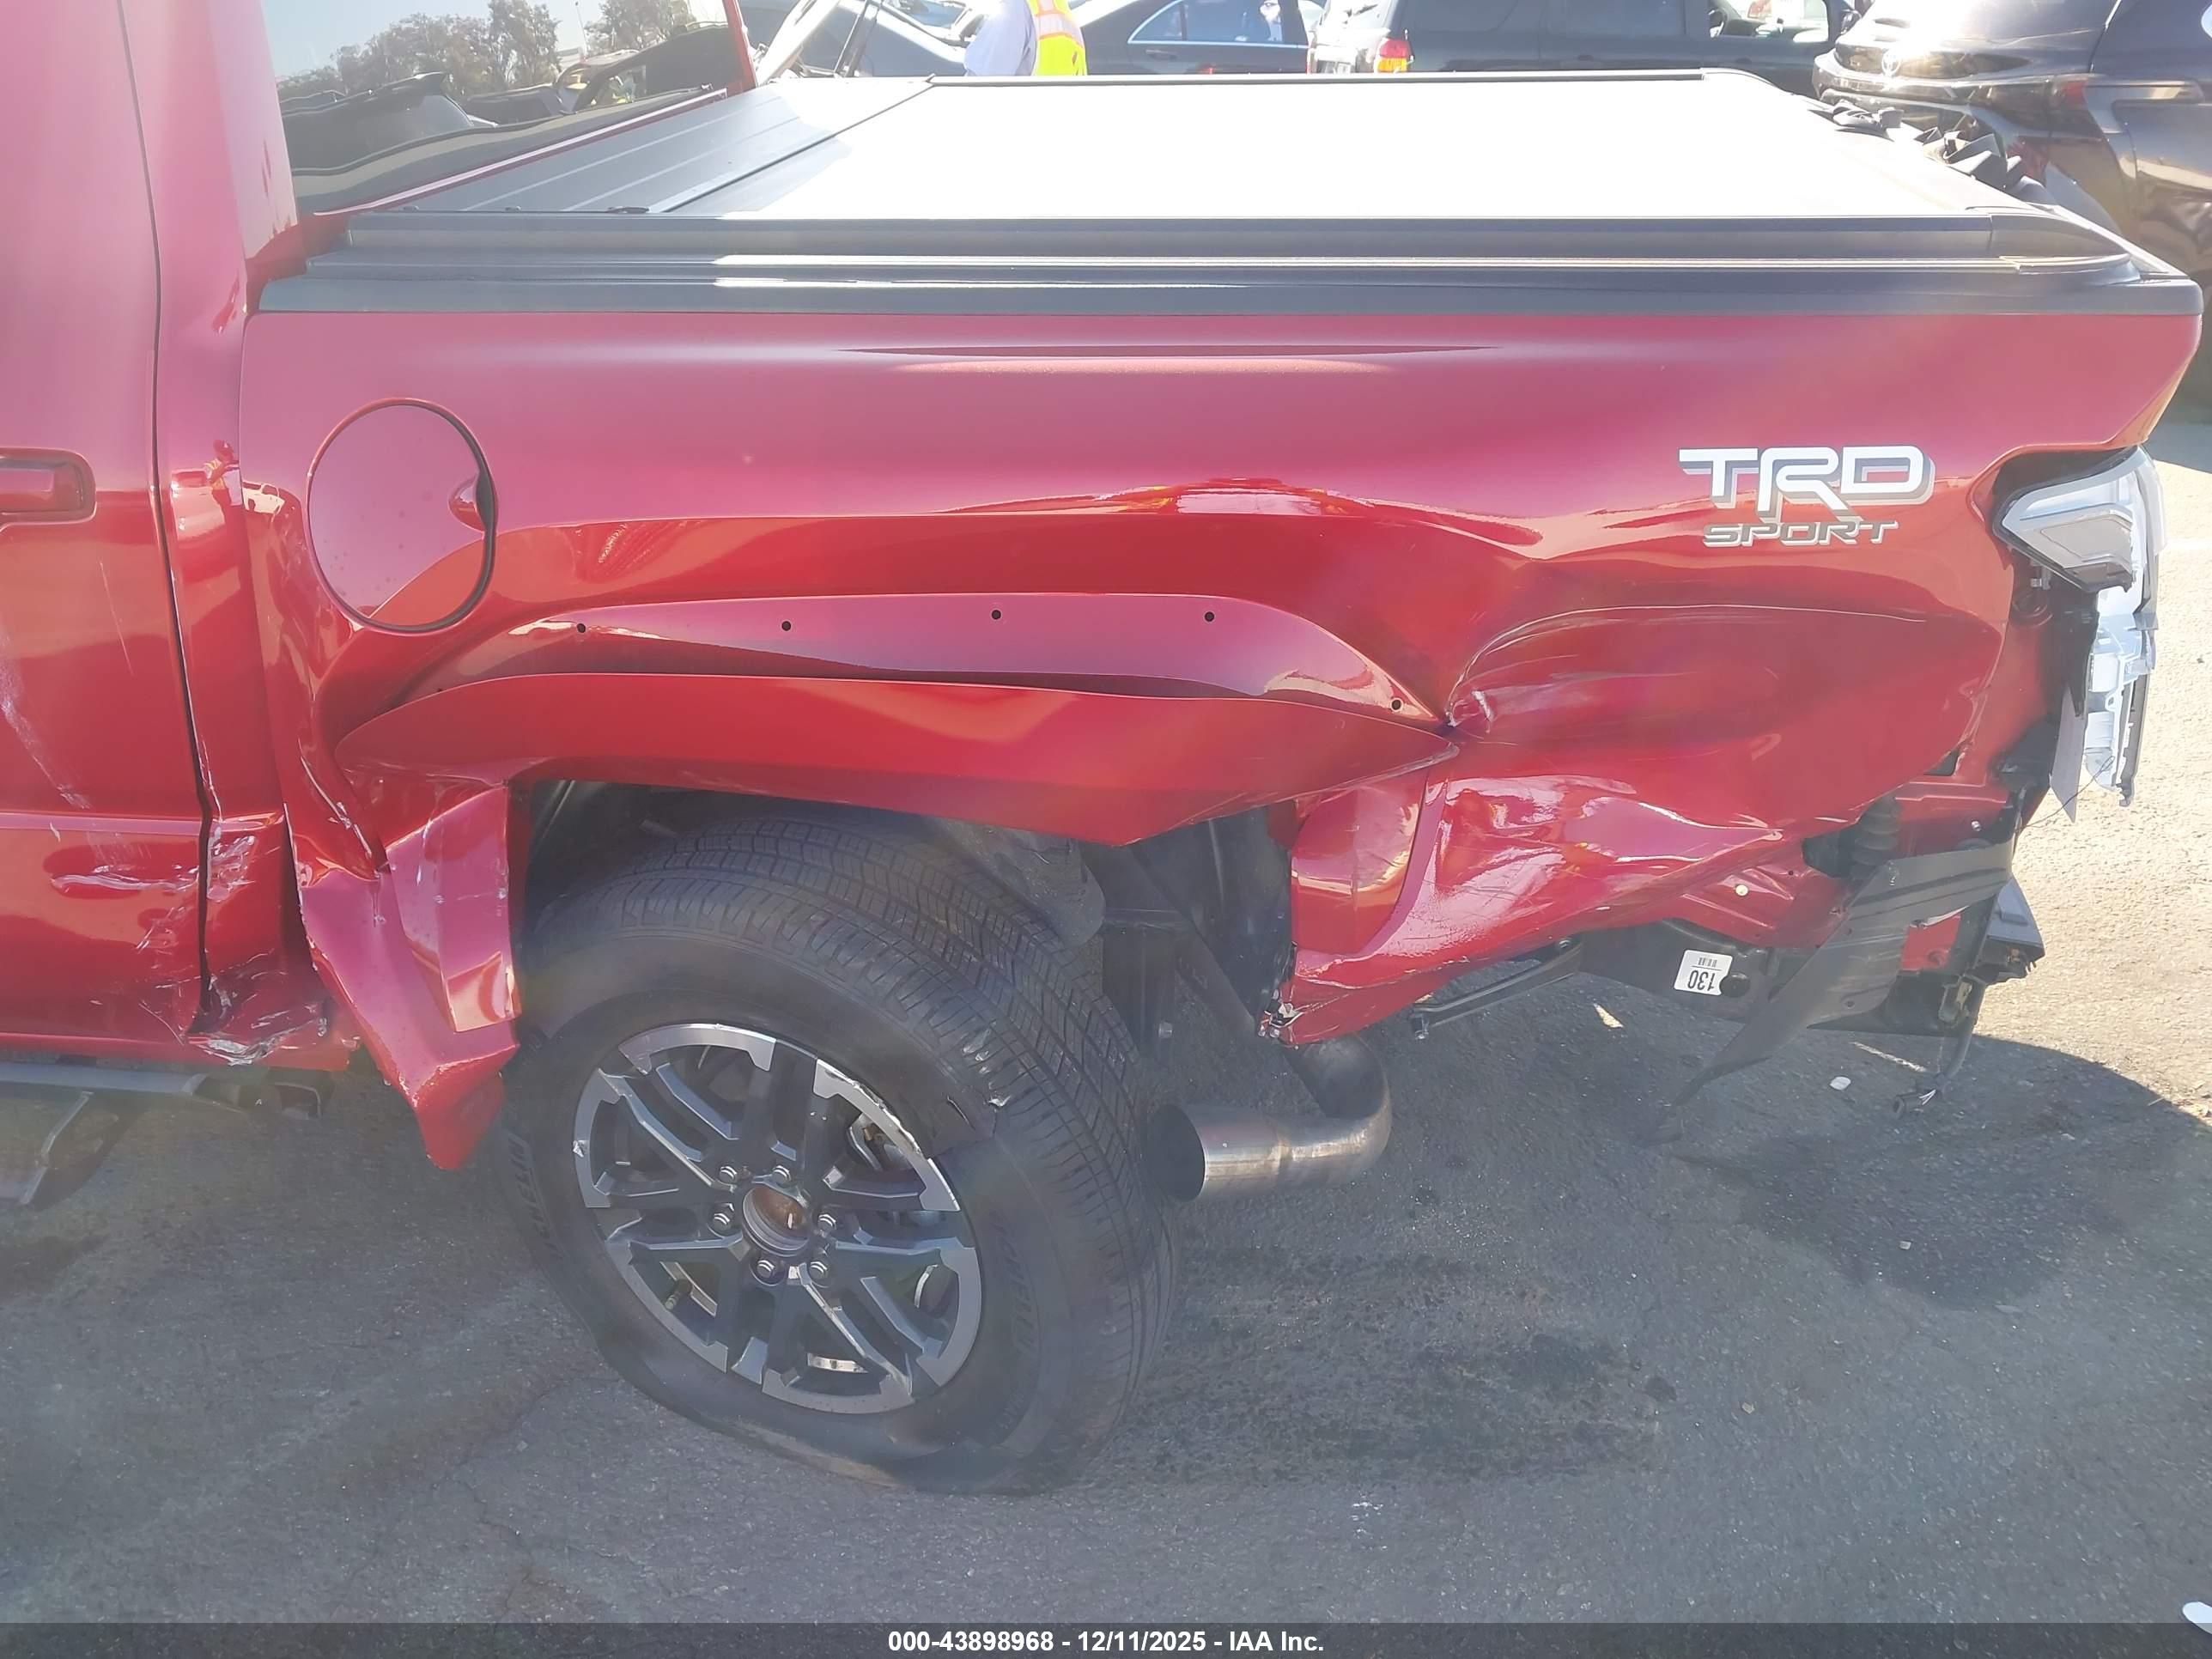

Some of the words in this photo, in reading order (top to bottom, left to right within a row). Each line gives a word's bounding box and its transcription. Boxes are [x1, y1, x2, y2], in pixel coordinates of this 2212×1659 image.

[1679, 446, 1935, 520] TRD
[1704, 520, 1899, 547] SPORT
[1687, 969, 1716, 991] 130
